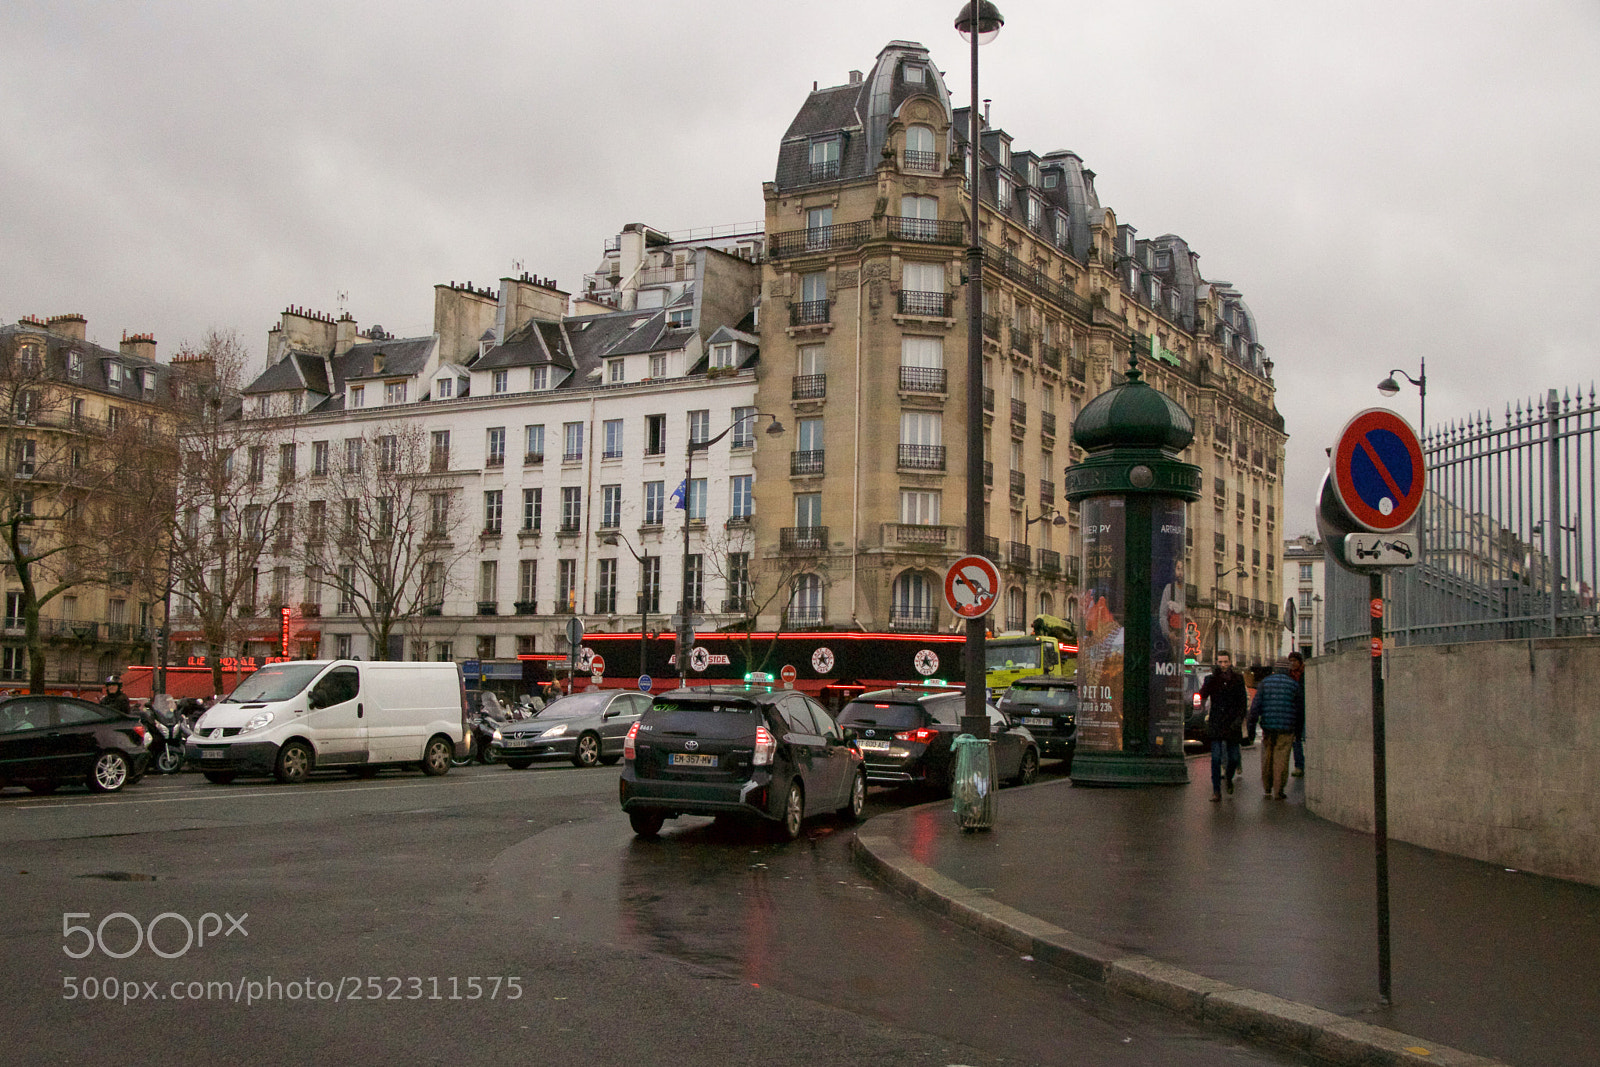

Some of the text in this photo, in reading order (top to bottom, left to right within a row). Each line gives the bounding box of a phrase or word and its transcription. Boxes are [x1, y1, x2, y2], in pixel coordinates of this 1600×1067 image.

[1099, 524, 1111, 533] PY
[187, 656, 206, 666] LE
[708, 655, 727, 663] SIDE
[1088, 685, 1098, 699] ET
